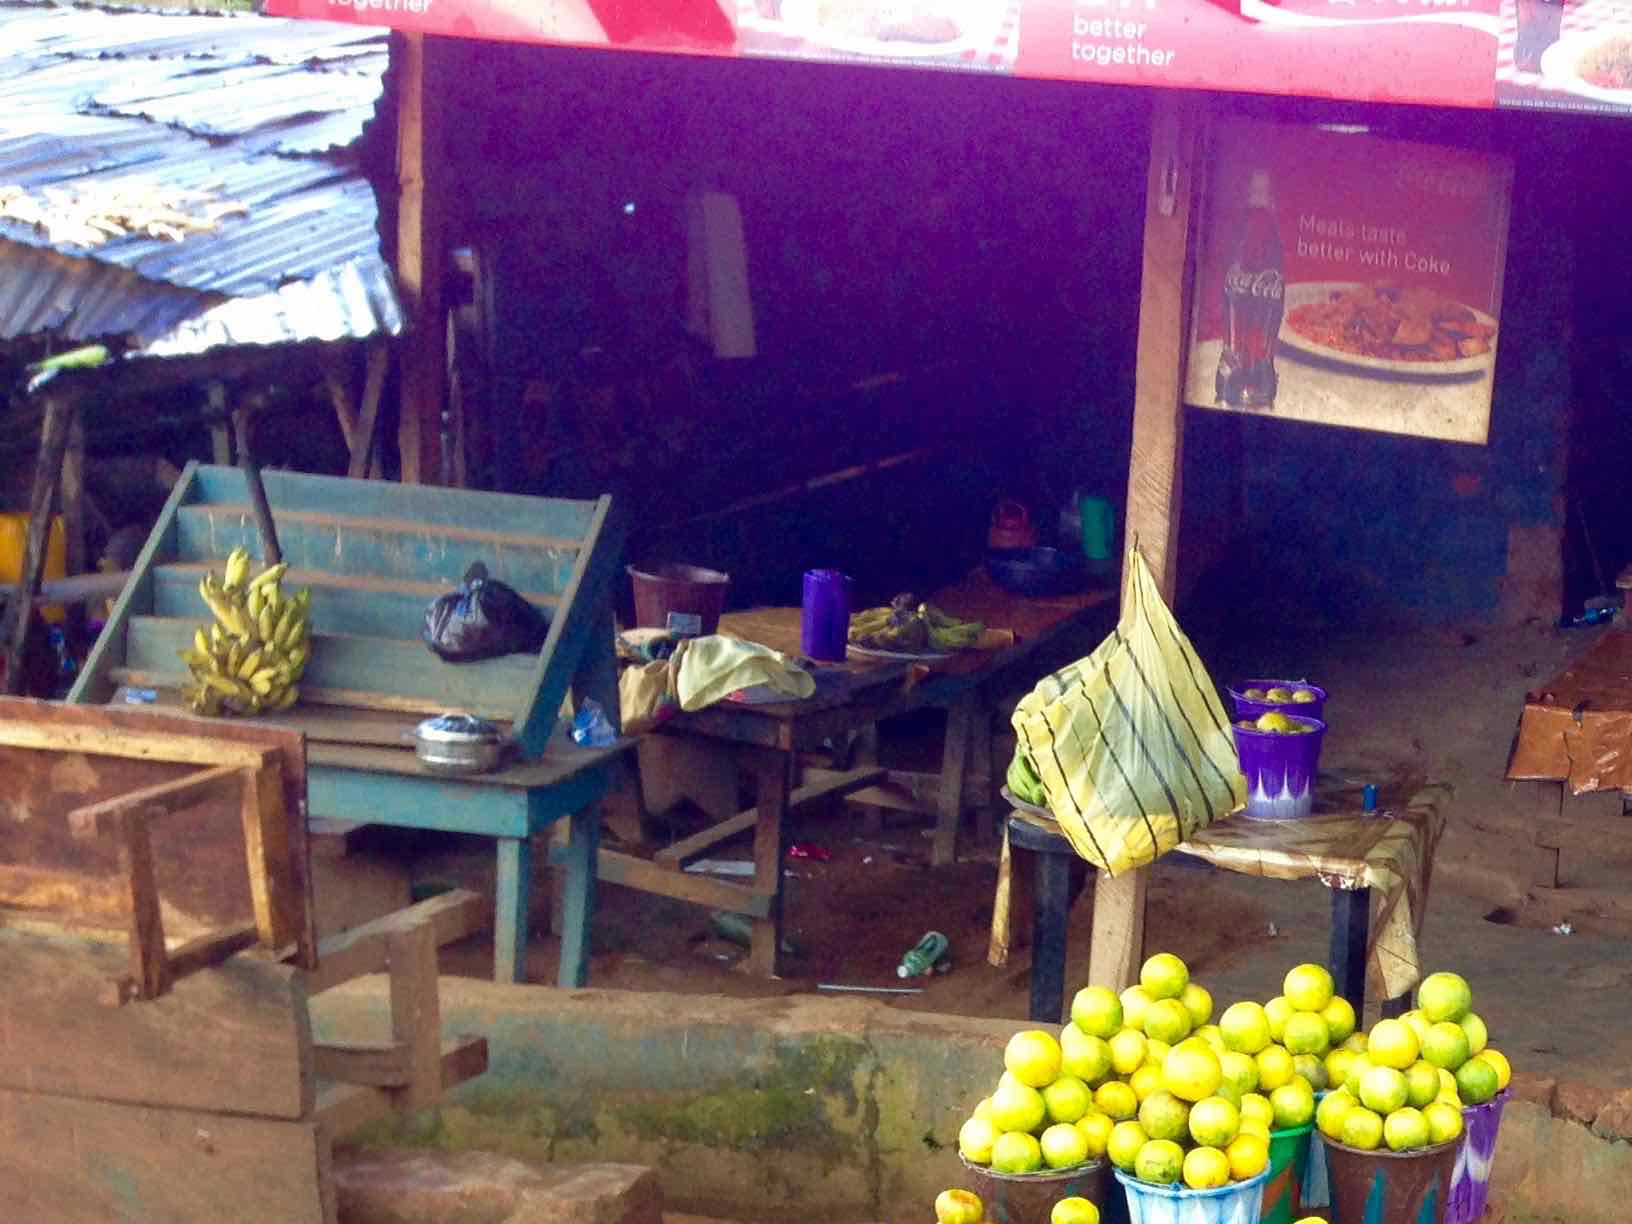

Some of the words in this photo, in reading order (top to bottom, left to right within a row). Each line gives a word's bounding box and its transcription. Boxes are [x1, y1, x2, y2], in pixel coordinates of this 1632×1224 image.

[1072, 14, 1148, 39] better
[1071, 40, 1176, 66] together
[1296, 235, 1350, 261] better
[1360, 248, 1399, 269] with
[1405, 253, 1451, 275] Coke
